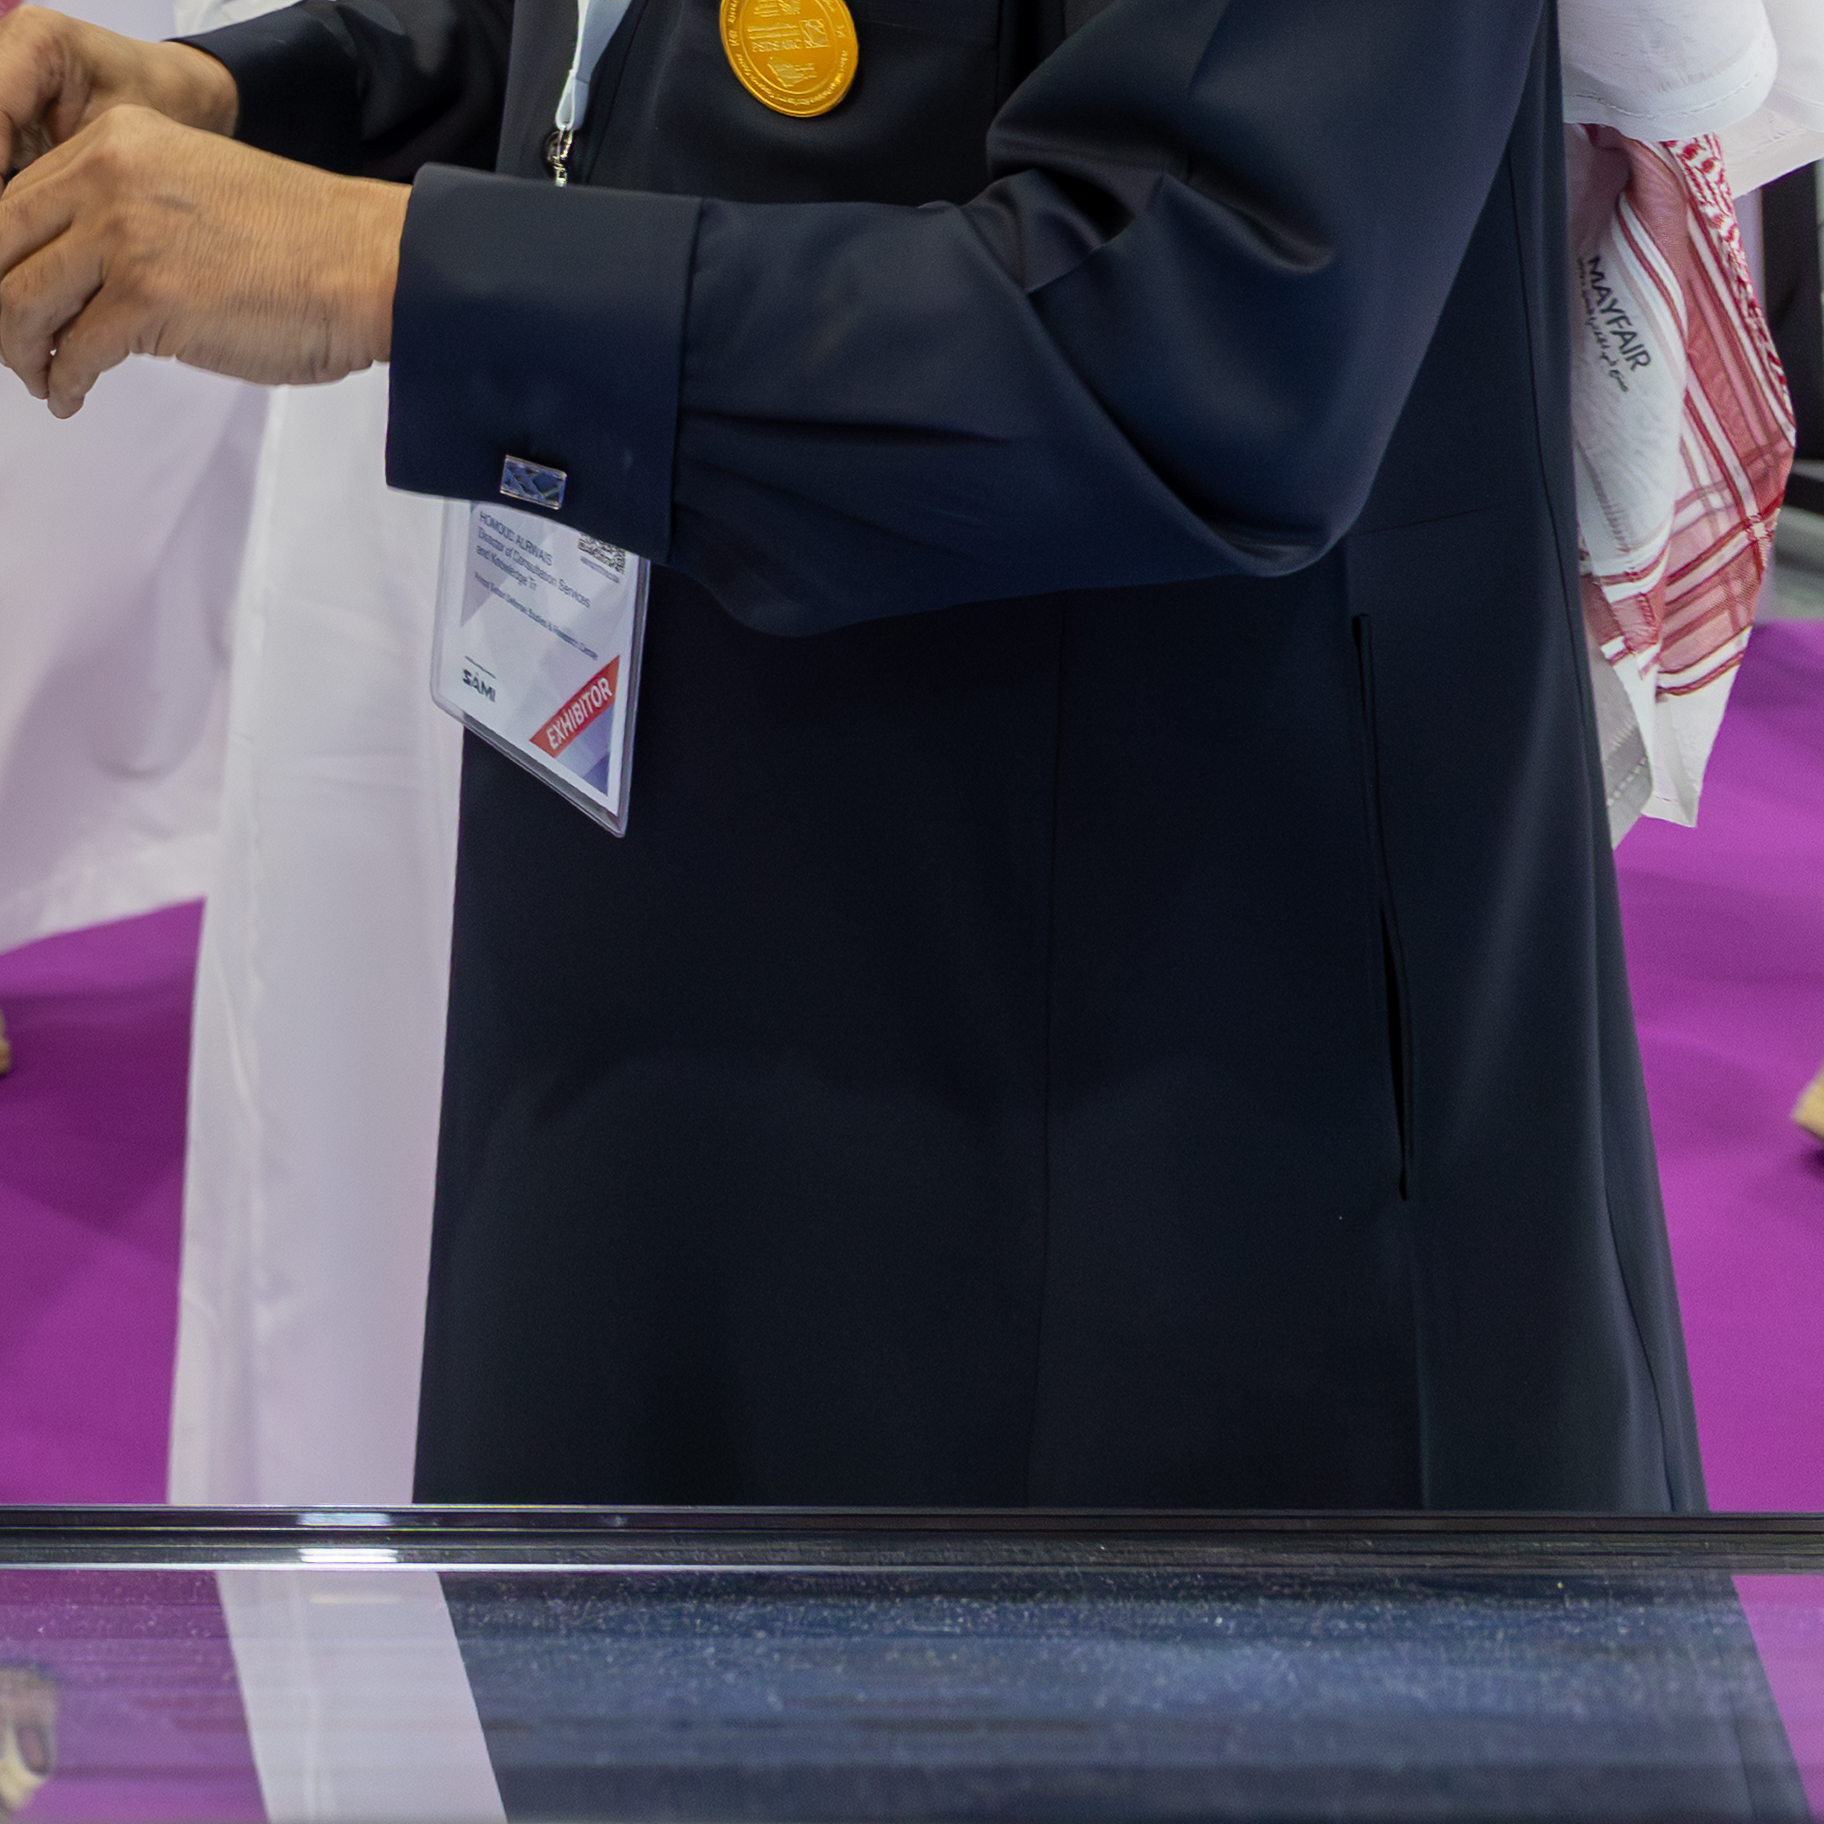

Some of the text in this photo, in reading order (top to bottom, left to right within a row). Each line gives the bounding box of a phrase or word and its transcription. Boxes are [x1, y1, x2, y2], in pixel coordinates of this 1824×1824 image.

[1587, 255, 1652, 372] MAYFAIR
[558, 578, 592, 609] Services
[462, 668, 497, 703] SAMI
[546, 676, 613, 750] EXHIBITOR
